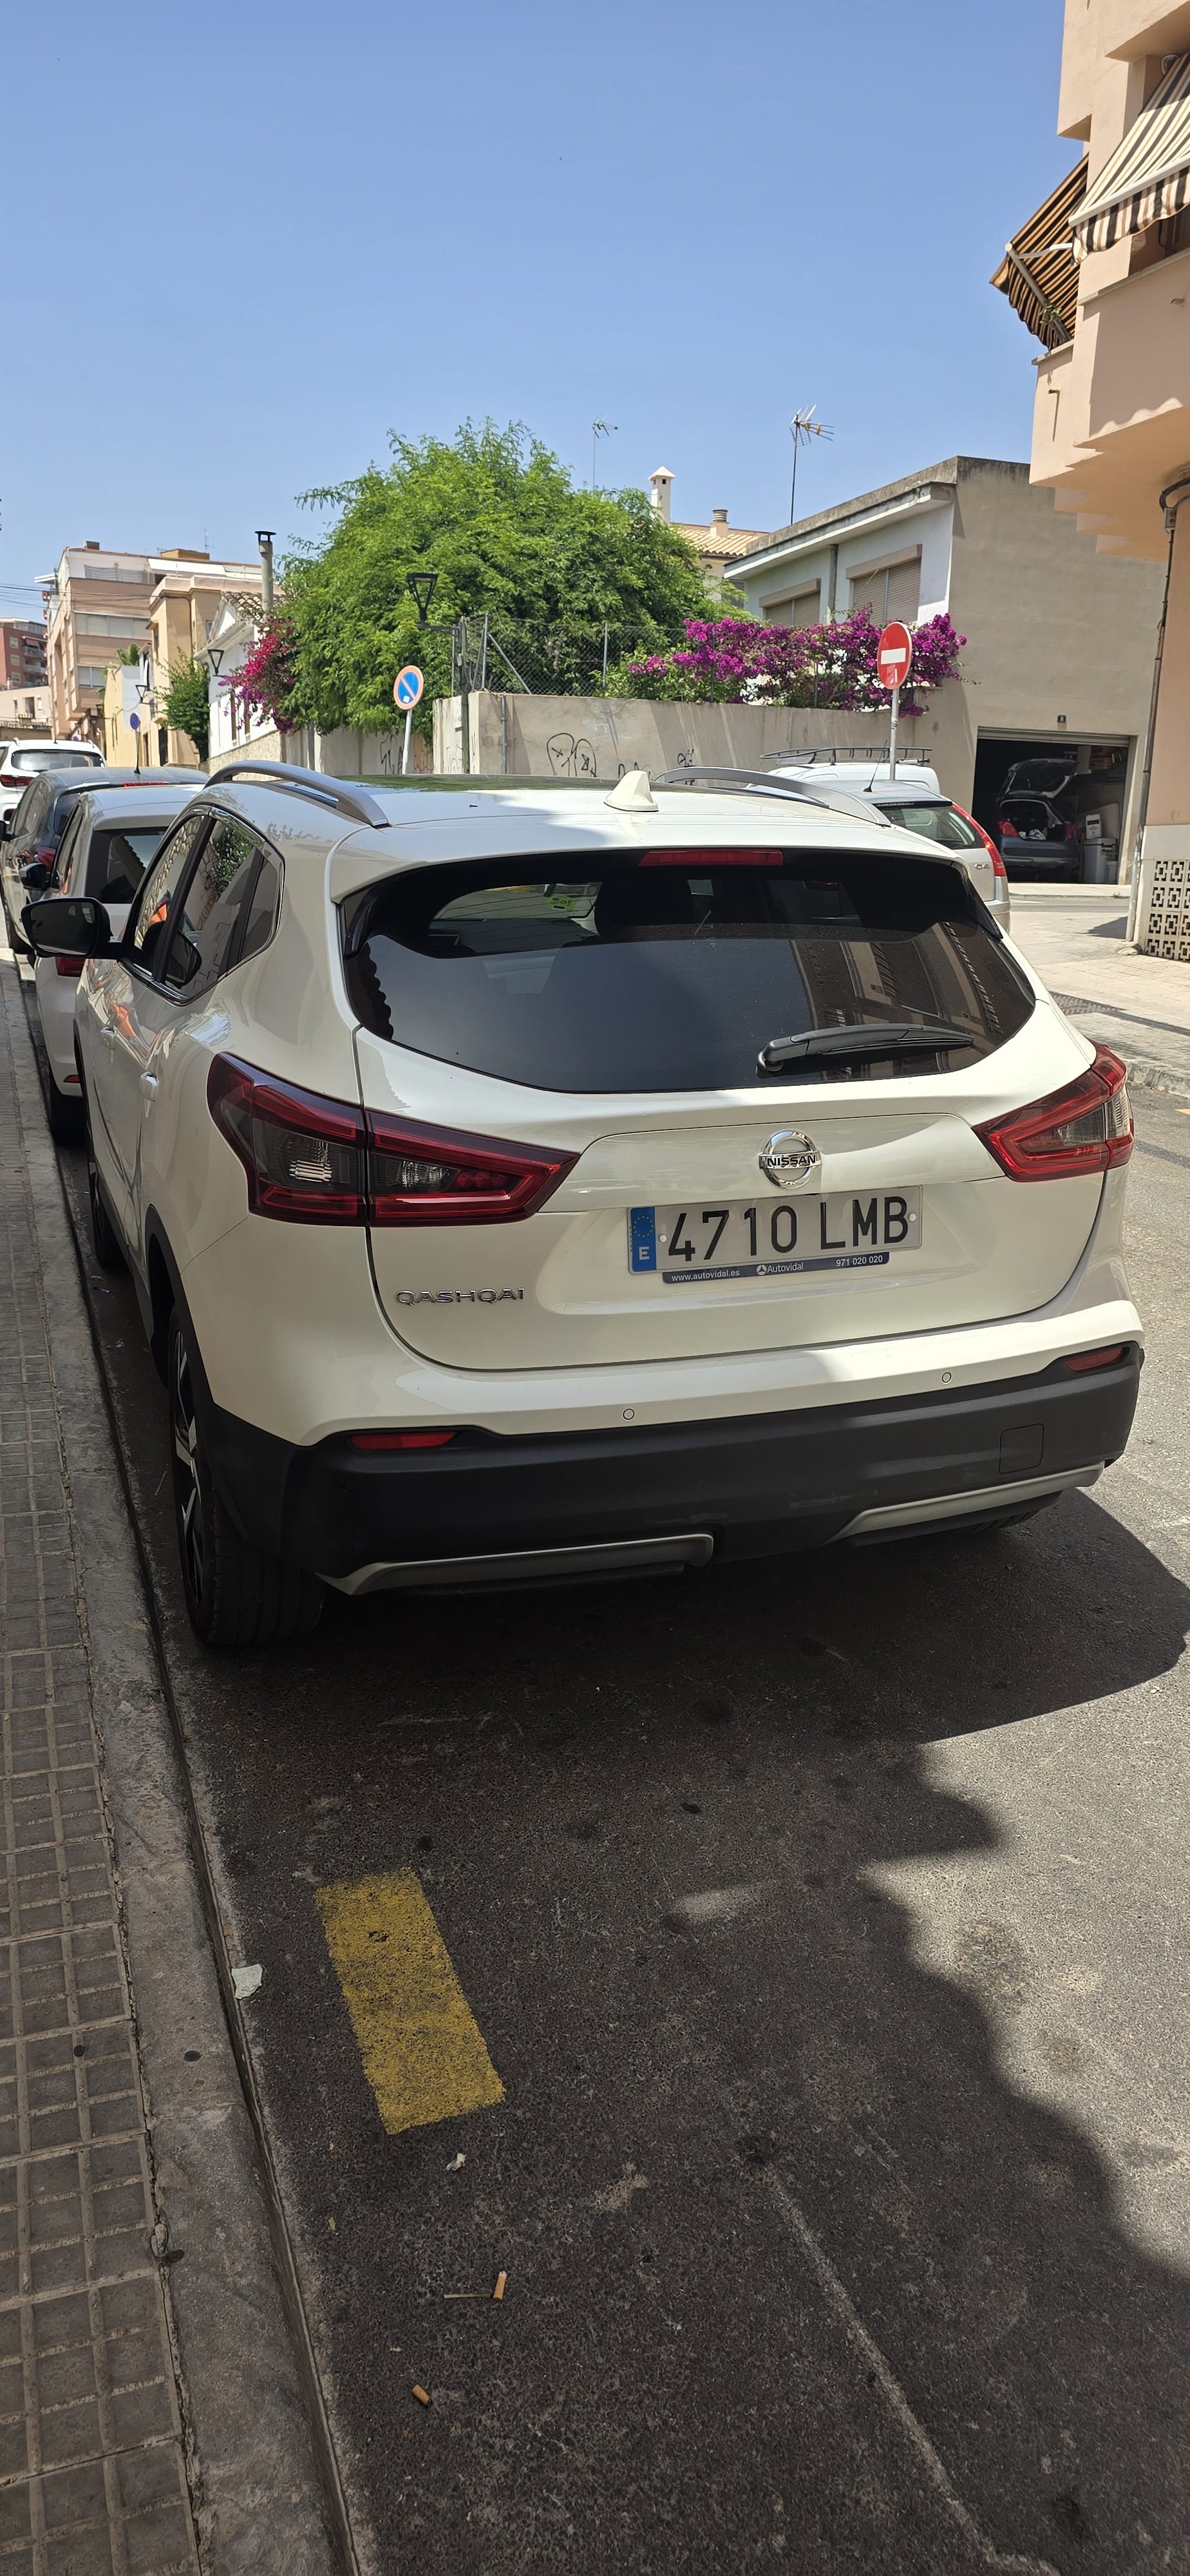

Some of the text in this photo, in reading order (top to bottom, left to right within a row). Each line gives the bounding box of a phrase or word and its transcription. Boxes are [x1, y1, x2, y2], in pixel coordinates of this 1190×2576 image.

[767, 1155, 816, 1167] NISSAN
[668, 1205, 797, 1262] 4710
[820, 1196, 909, 1250] LMB
[638, 1246, 650, 1260] E
[766, 1262, 804, 1273] Autovidal
[836, 1255, 883, 1267] 971 020 020
[671, 1269, 741, 1282] www.autovidal.es
[396, 1287, 525, 1307] QASHQAI
